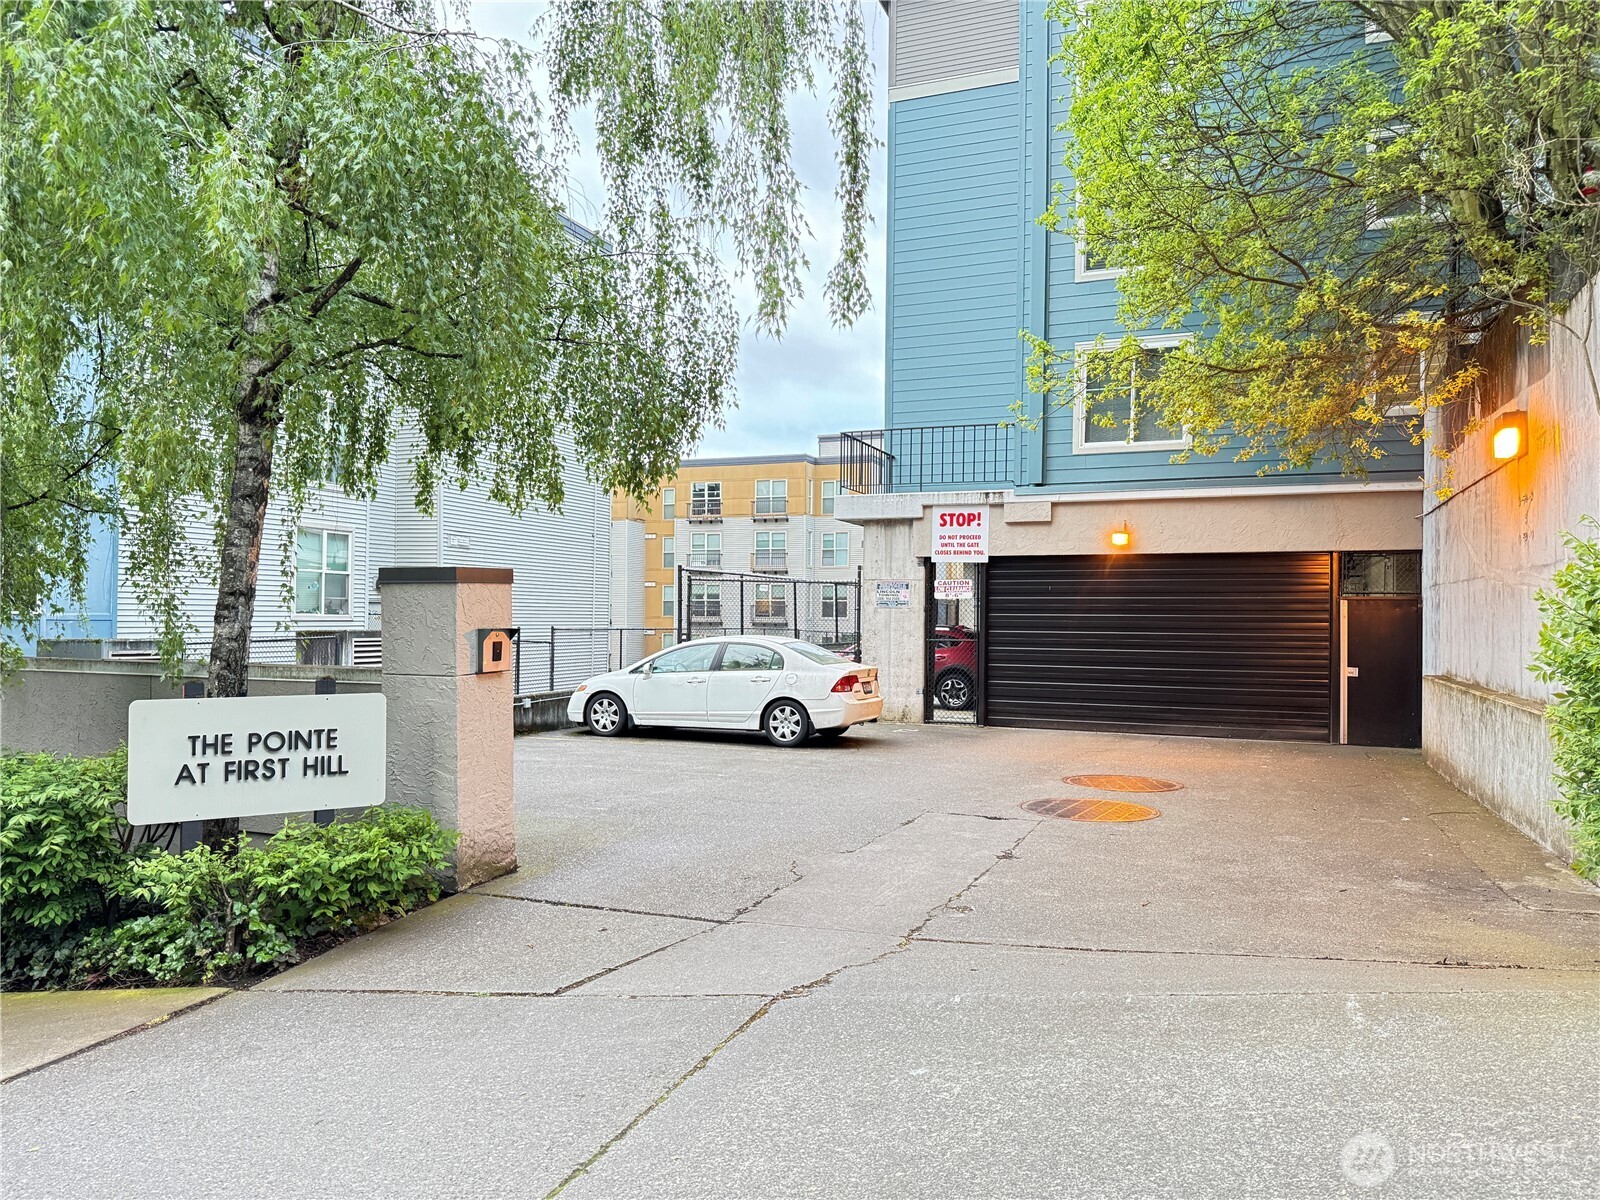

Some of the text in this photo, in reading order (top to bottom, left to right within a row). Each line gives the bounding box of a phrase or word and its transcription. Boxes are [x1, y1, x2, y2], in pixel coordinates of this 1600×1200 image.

[939, 511, 982, 527] STOP!
[187, 728, 338, 757] THE POINTE
[174, 754, 349, 786] AT FIRST HILL
